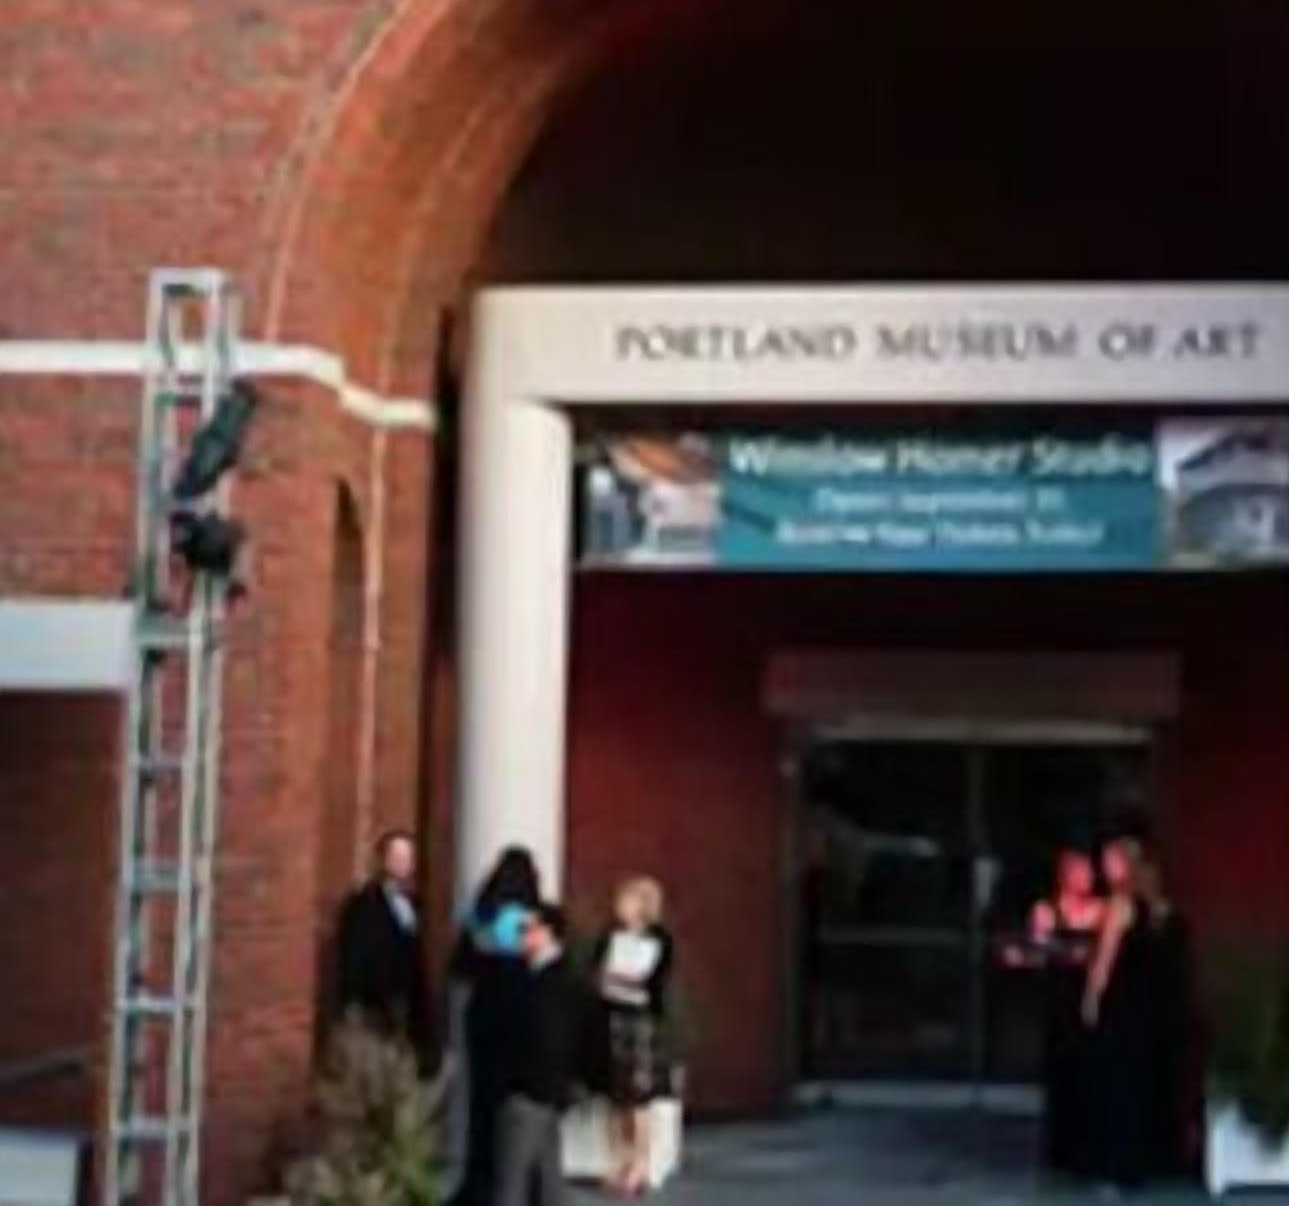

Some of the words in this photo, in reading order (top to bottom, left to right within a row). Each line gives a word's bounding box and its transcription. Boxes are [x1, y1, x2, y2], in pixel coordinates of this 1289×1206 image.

[615, 322, 857, 362] PORTLAND
[875, 323, 1078, 360] MUSEUM
[1098, 323, 1156, 360] OF
[1170, 322, 1266, 360] ART
